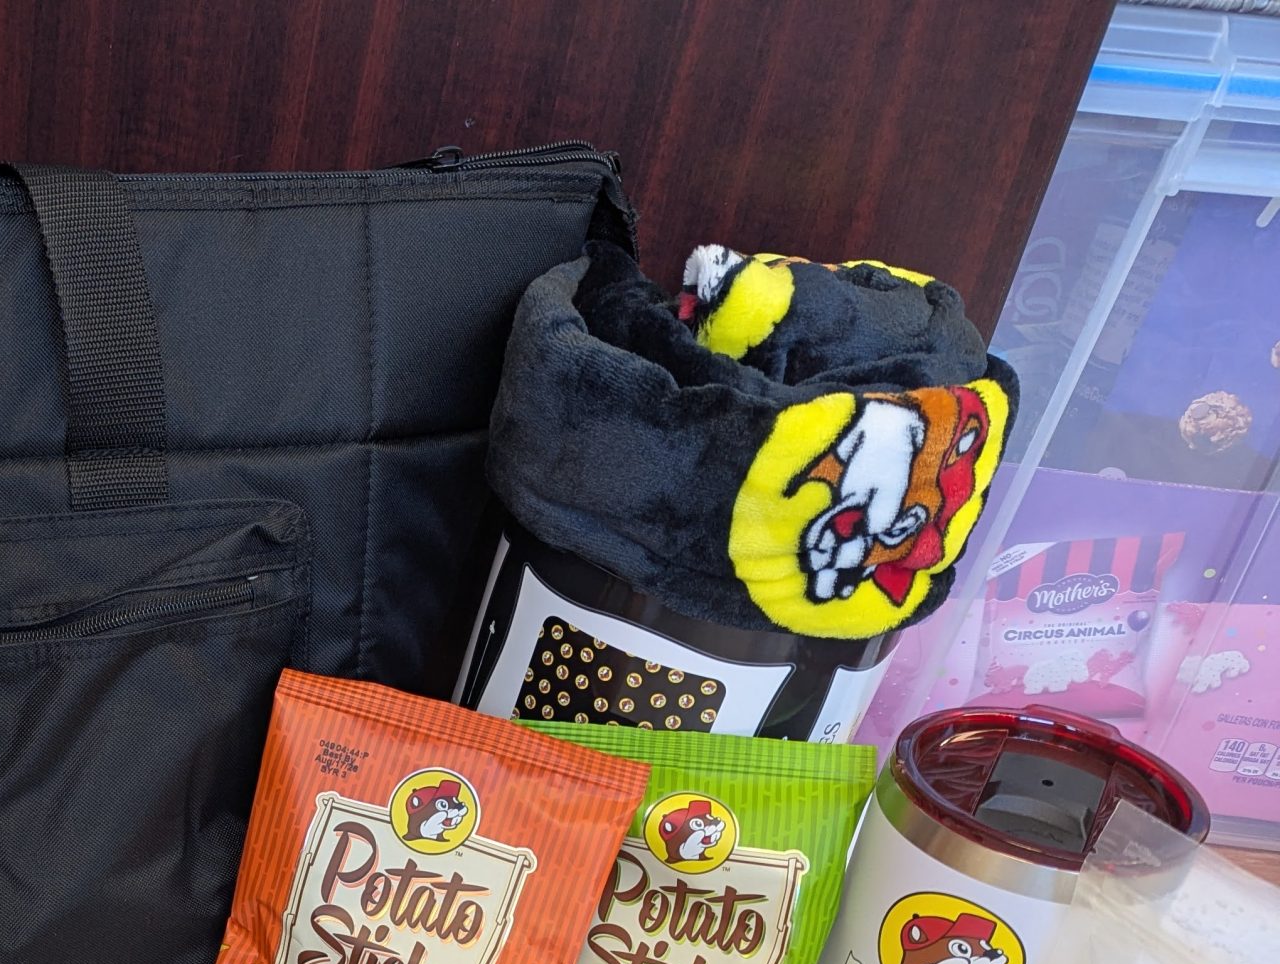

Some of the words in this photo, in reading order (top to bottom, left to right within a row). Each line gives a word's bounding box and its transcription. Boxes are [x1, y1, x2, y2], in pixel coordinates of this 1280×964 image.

[1033, 580, 1116, 608] Mother's
[1004, 629, 1064, 641] CIRCUS
[1065, 623, 1126, 638] ANIMAL
[1223, 740, 1246, 752] 140
[319, 820, 490, 945] Potato
[598, 851, 770, 955] Potato
